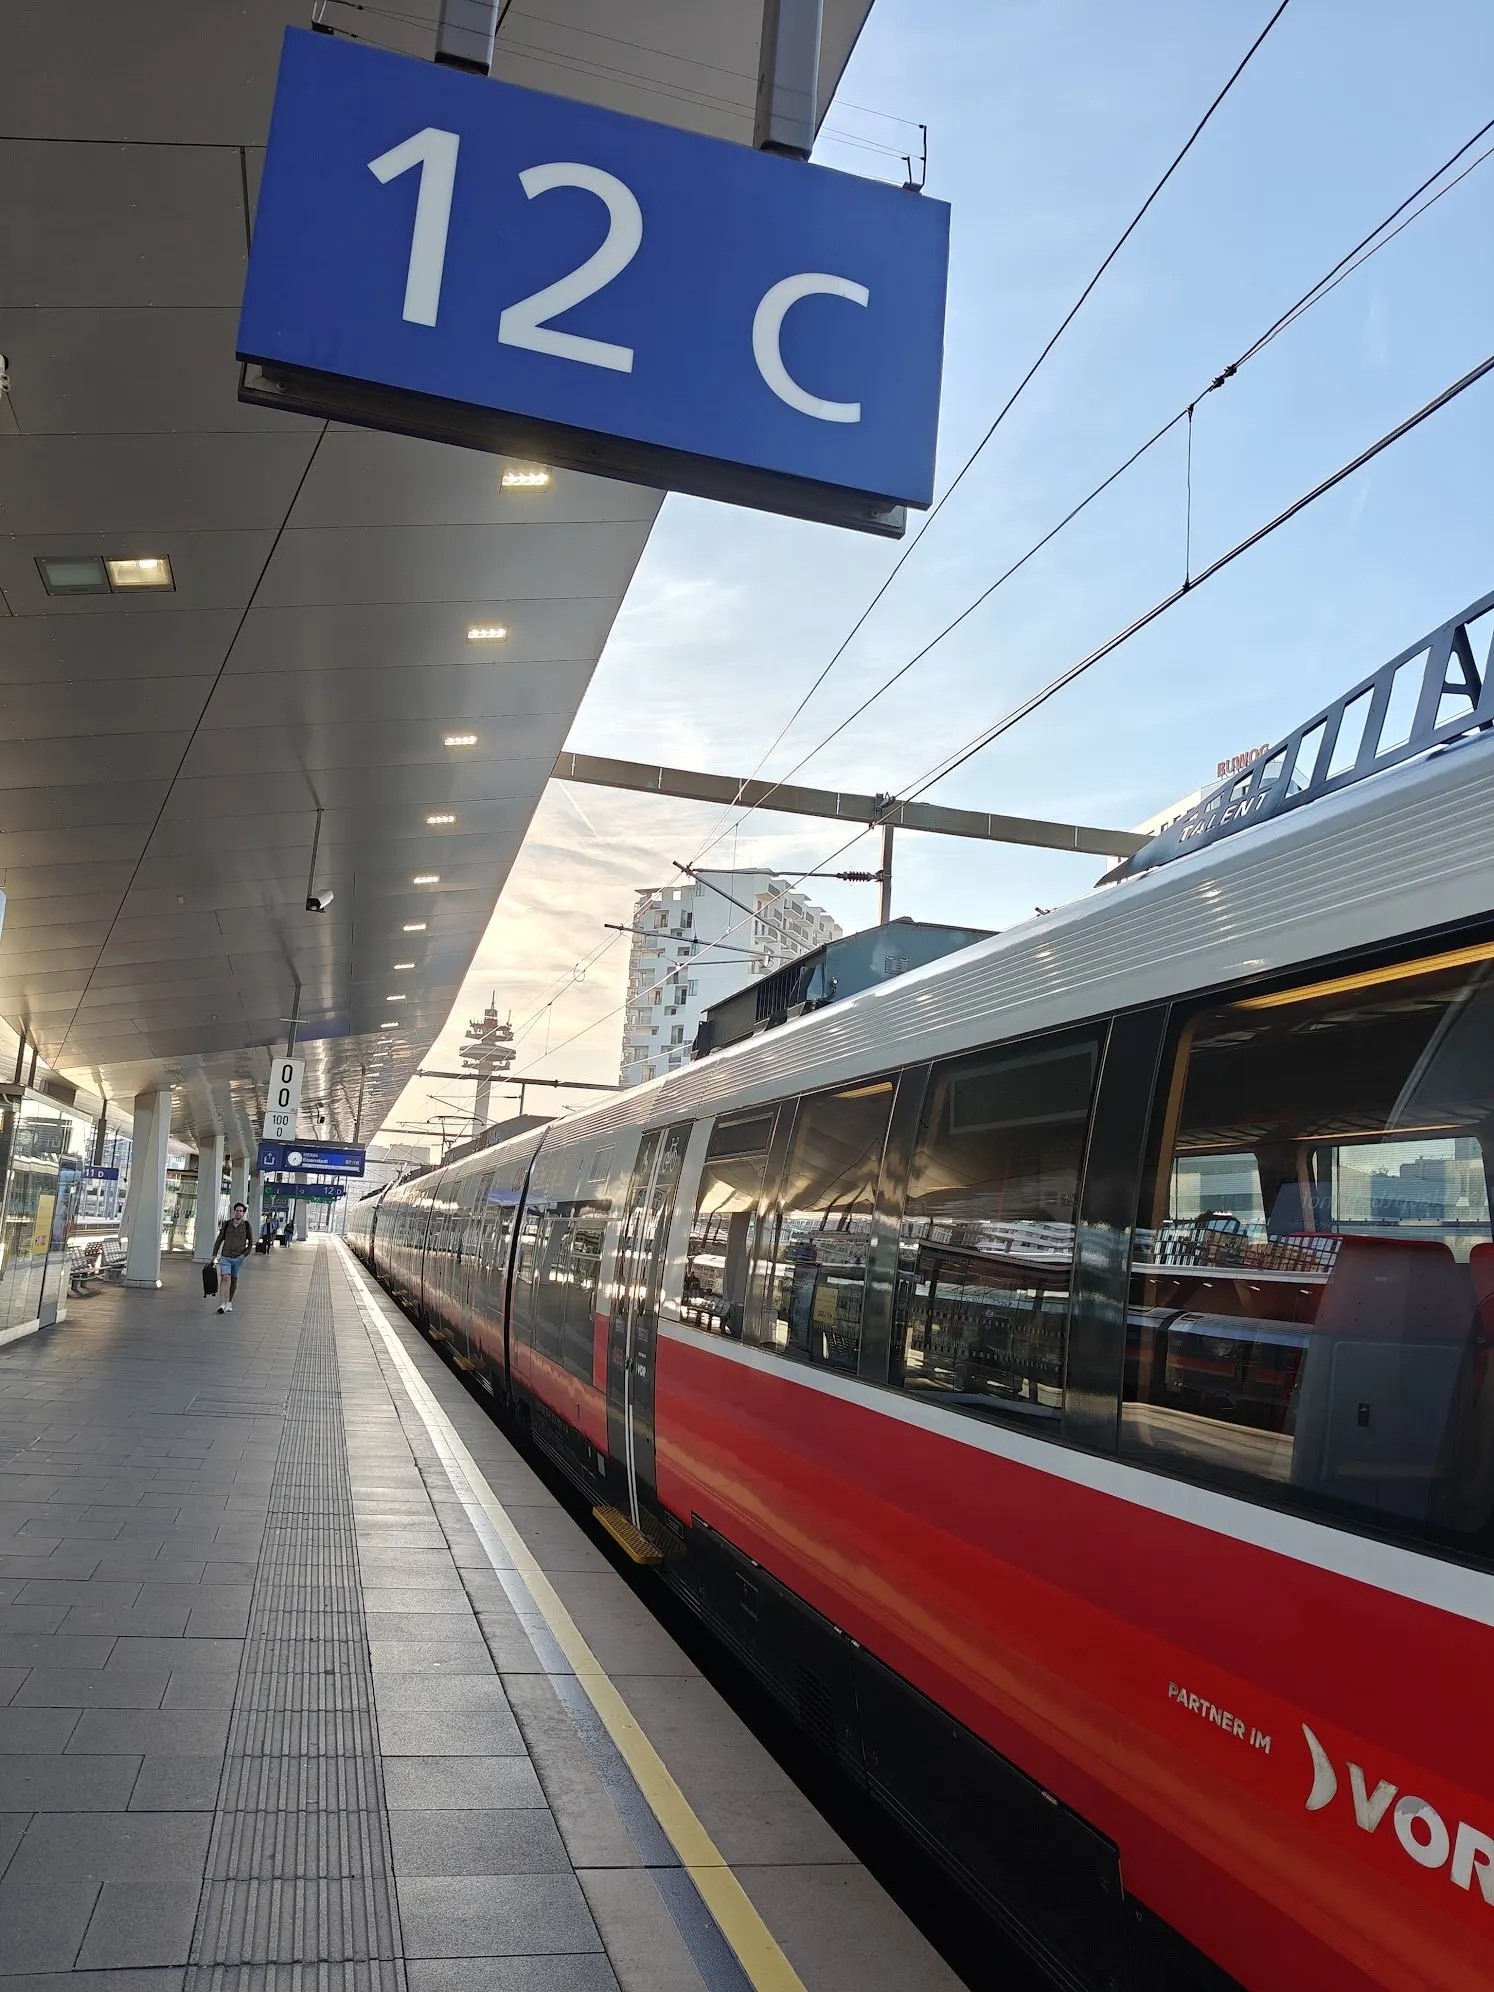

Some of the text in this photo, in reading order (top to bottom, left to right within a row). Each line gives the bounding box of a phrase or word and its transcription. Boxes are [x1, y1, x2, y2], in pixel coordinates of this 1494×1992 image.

[367, 127, 870, 424] 12 C
[1179, 788, 1272, 843] TALENT
[281, 1064, 293, 1084] 0
[278, 1088, 290, 1107] 0
[272, 1114, 289, 1126] 100
[276, 1127, 283, 1137] 0
[85, 1168, 95, 1177] 11
[323, 1186, 334, 1195] 12
[1168, 1680, 1272, 1755] PARTNER IM
[1346, 1760, 1494, 1908] VOR
